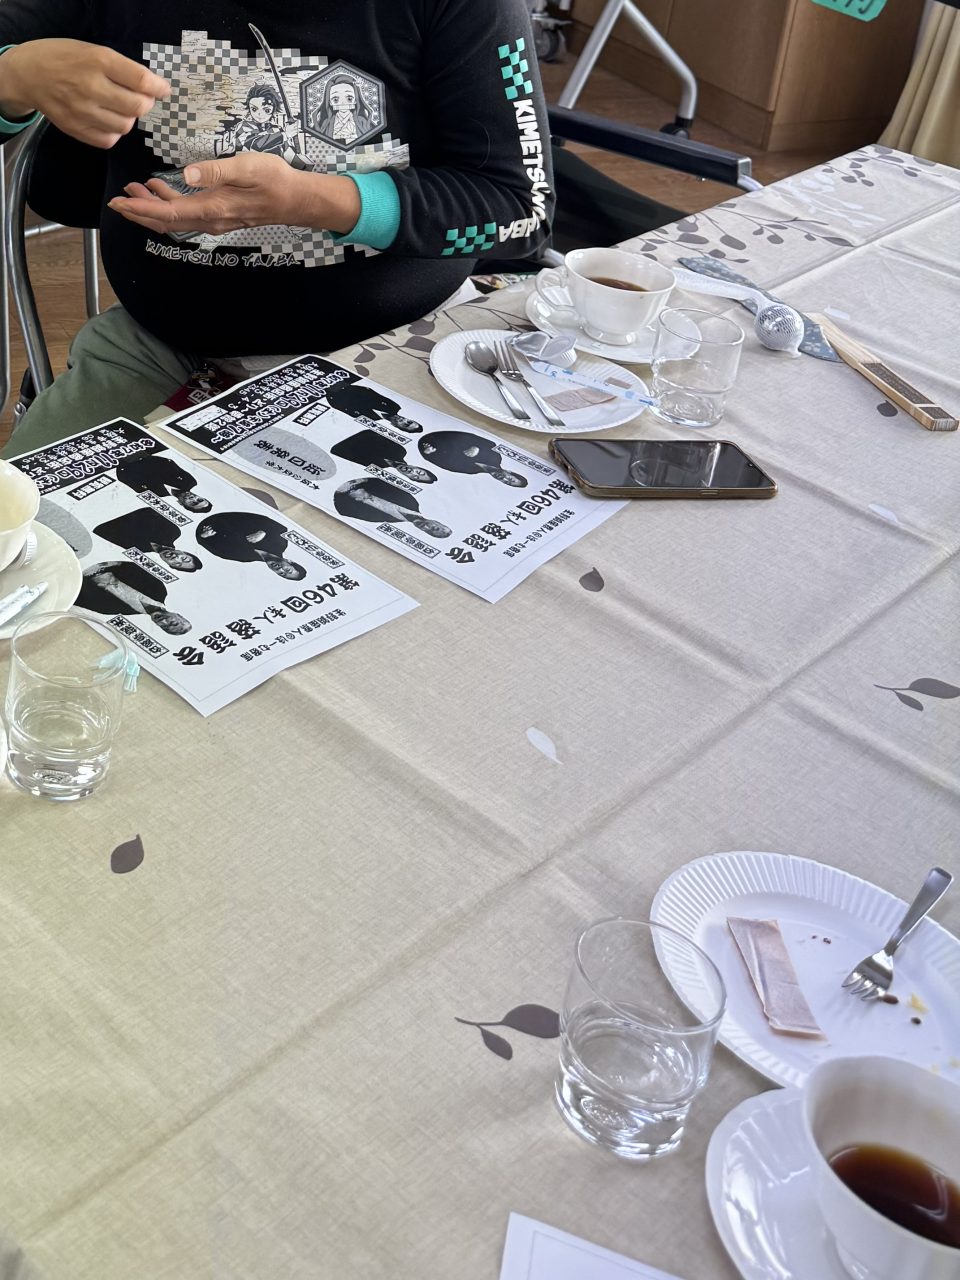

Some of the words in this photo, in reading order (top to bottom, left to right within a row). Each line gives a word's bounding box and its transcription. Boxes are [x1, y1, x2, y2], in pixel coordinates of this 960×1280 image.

[145, 239, 213, 266] KIMETSU
[214, 253, 239, 267] NO
[241, 252, 301, 268] YAIBA
[253, 439, 325, 475] 近日発表
[444, 478, 579, 563] 第46回素人落語会
[172, 572, 359, 665] 第46回素人落語会
